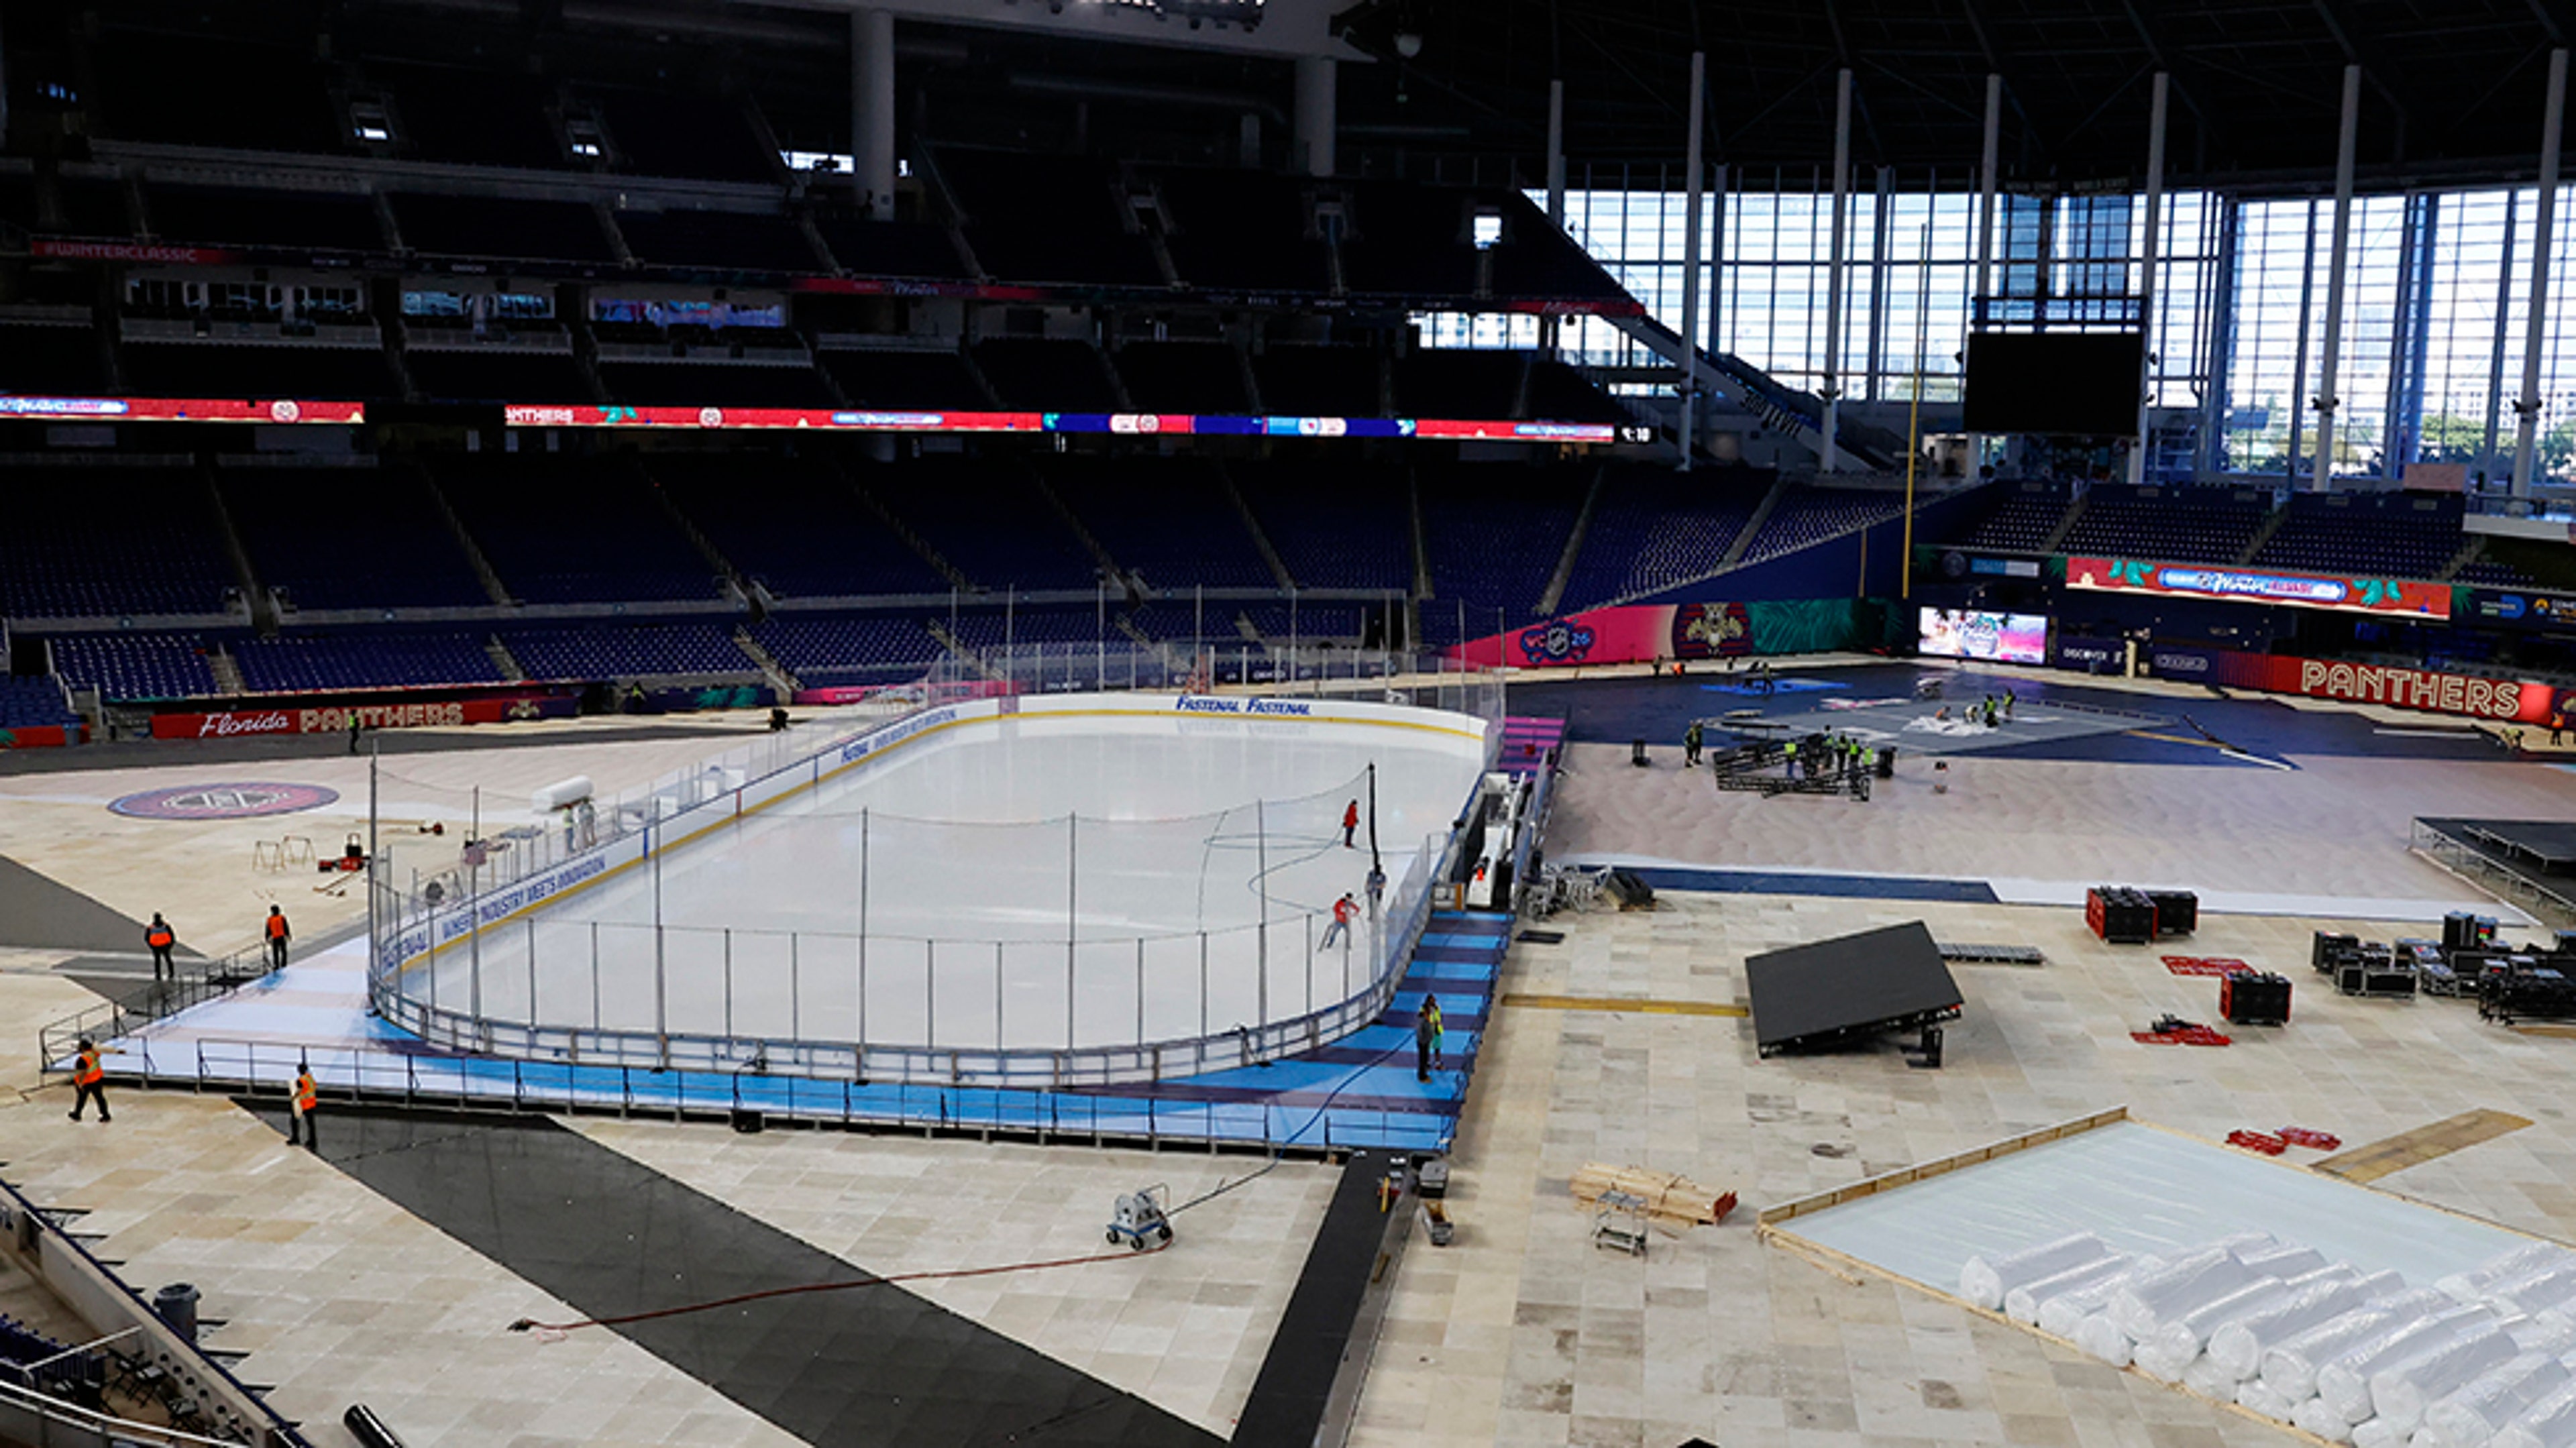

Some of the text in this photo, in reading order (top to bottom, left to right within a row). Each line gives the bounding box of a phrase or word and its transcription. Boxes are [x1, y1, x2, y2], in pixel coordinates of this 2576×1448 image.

[44, 243, 198, 263] #WINTERCLASSIC
[2300, 659, 2520, 718] PANTHERS
[299, 702, 465, 732] PANTHERS
[1177, 695, 1310, 715] FASTENAL FASTENAL
[199, 712, 290, 737] Florida
[480, 889, 524, 923] INDUSTRY
